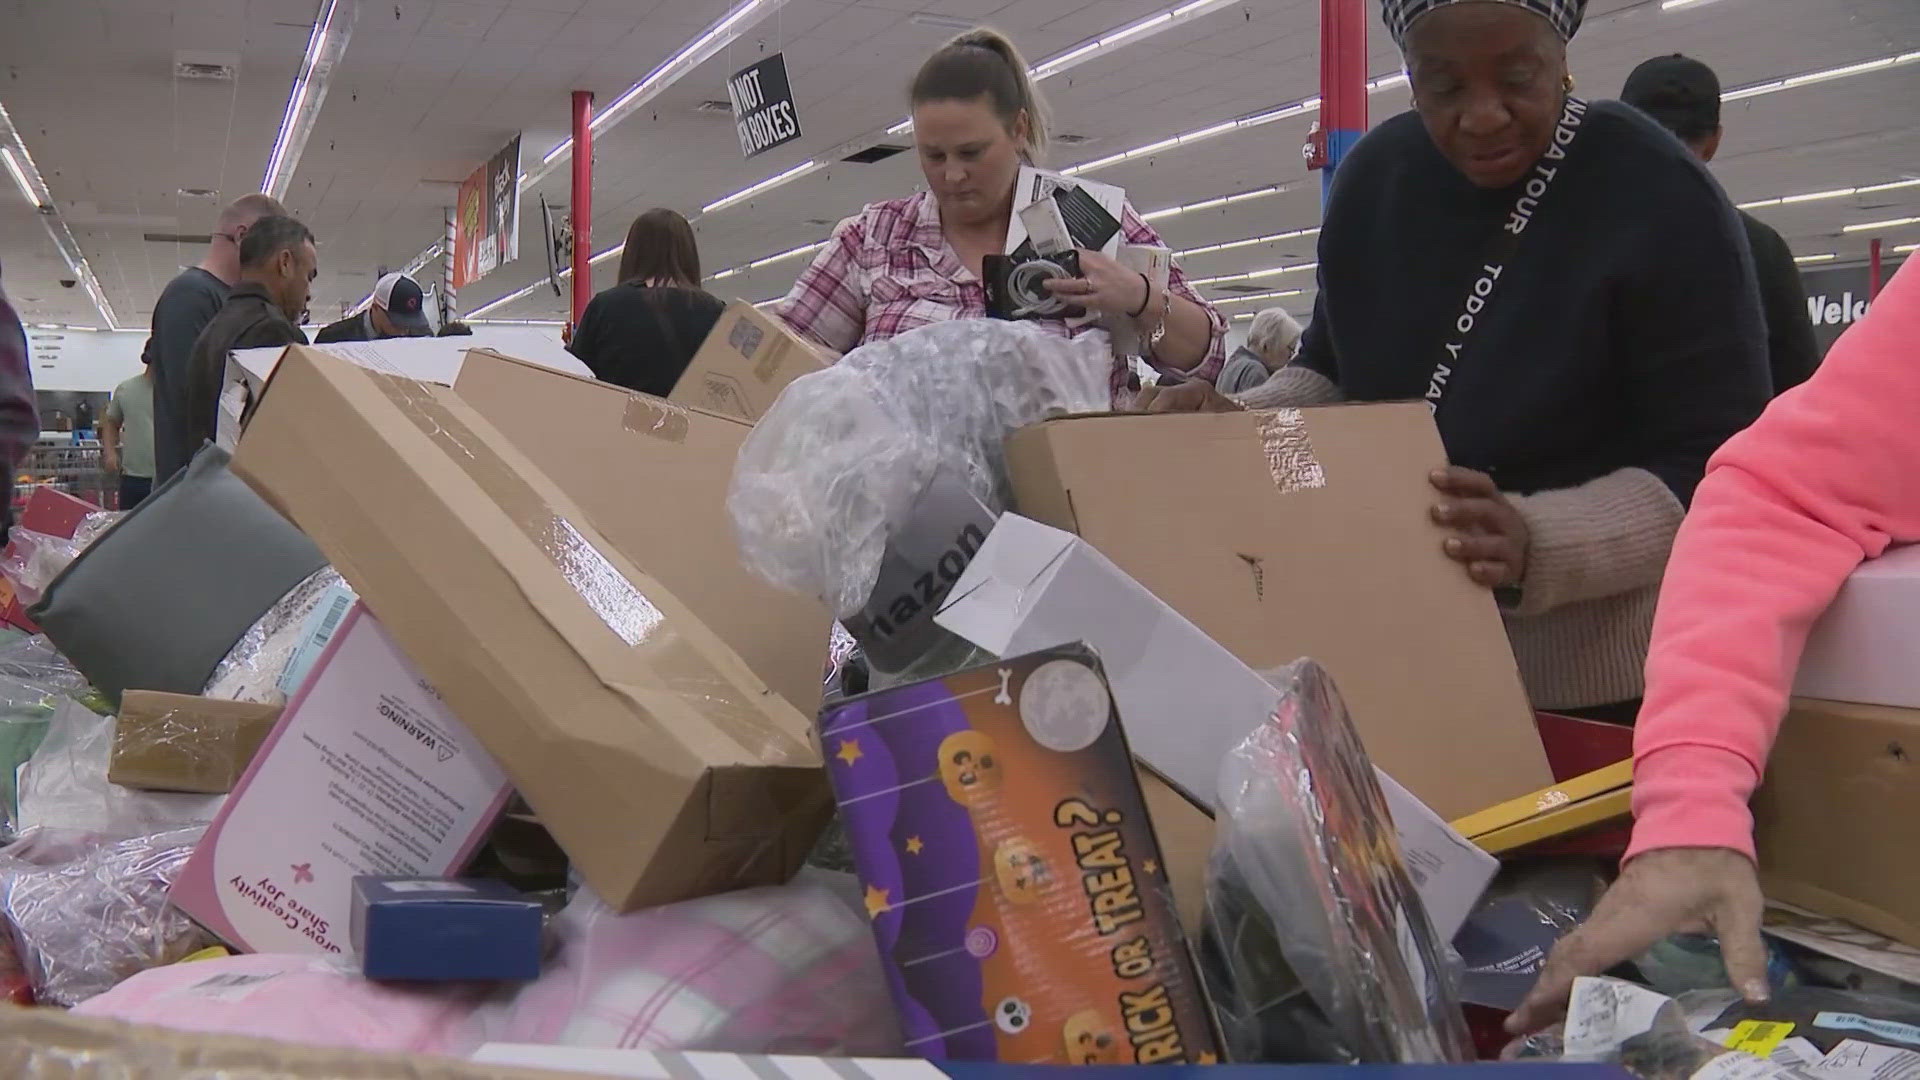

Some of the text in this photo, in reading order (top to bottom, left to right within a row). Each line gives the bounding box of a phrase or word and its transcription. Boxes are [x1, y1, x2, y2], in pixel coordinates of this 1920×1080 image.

[735, 68, 764, 113] NOT
[747, 100, 796, 150] BOXES
[1544, 100, 1587, 160] NADA
[1504, 165, 1557, 235] TOUR
[1457, 262, 1503, 333] TODO
[1807, 291, 1871, 326] Welc
[1445, 341, 1462, 360] Y
[376, 703, 435, 747] WARNING:
[229, 874, 299, 928] Creativity
[256, 876, 328, 933] Share Joy
[1054, 797, 1186, 1065] RICK OR TREAT?
